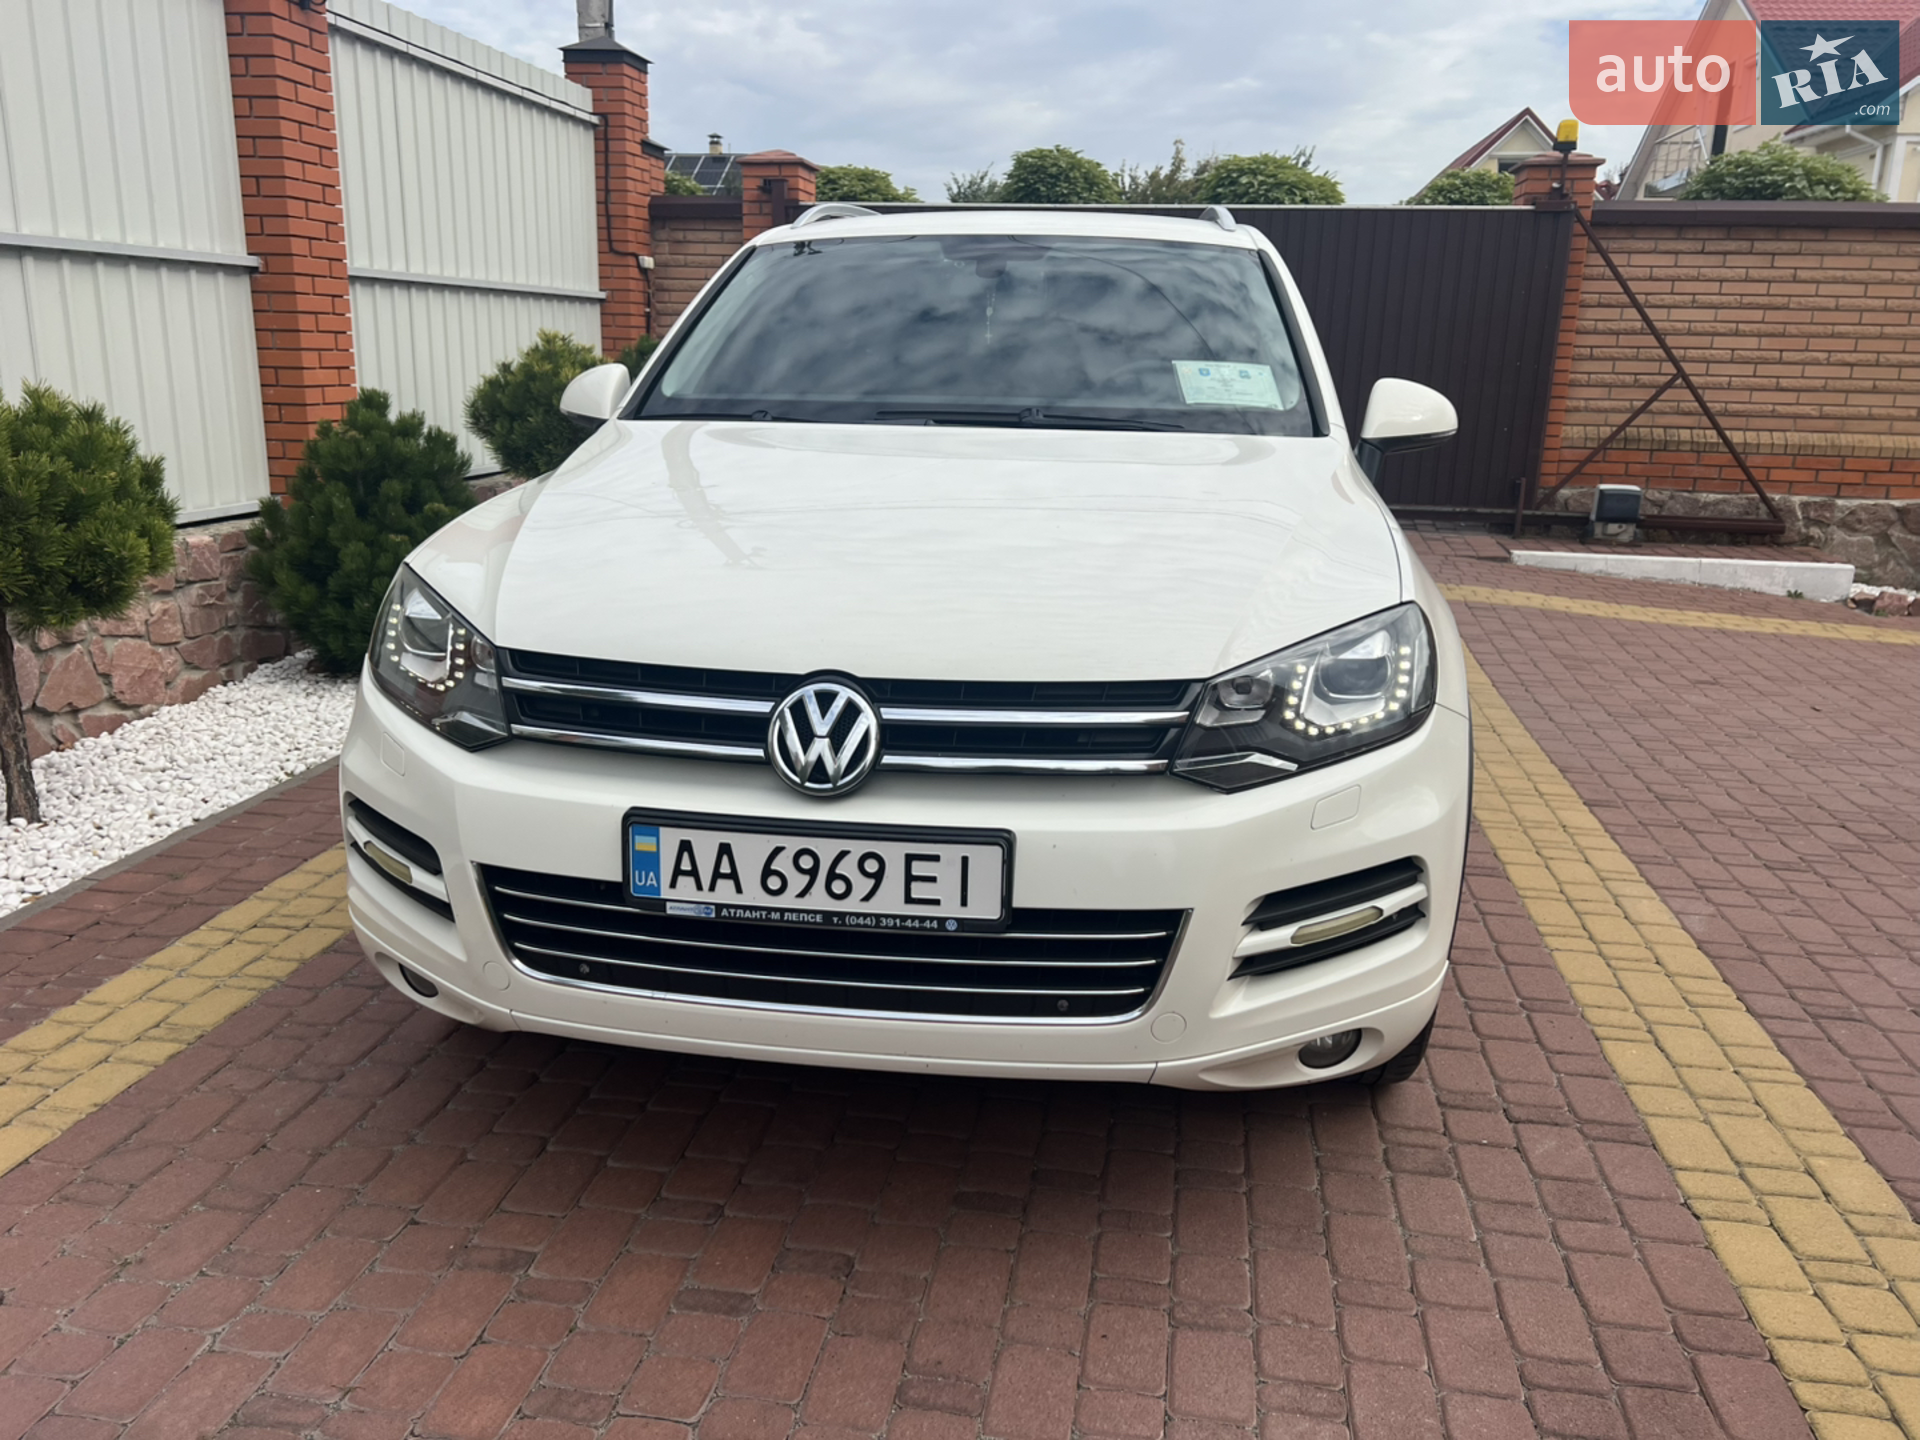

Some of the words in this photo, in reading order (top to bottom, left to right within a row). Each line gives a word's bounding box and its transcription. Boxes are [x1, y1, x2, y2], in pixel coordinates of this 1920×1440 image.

[635, 870, 658, 887] UA
[669, 839, 744, 895] AA
[760, 846, 886, 902] 6969
[904, 853, 969, 908] EI
[721, 908, 781, 920] АТЛАНТ-М
[784, 911, 824, 923] ЛЕПСЕ
[845, 915, 876, 927] (044)
[879, 917, 938, 929] 391-44-44
